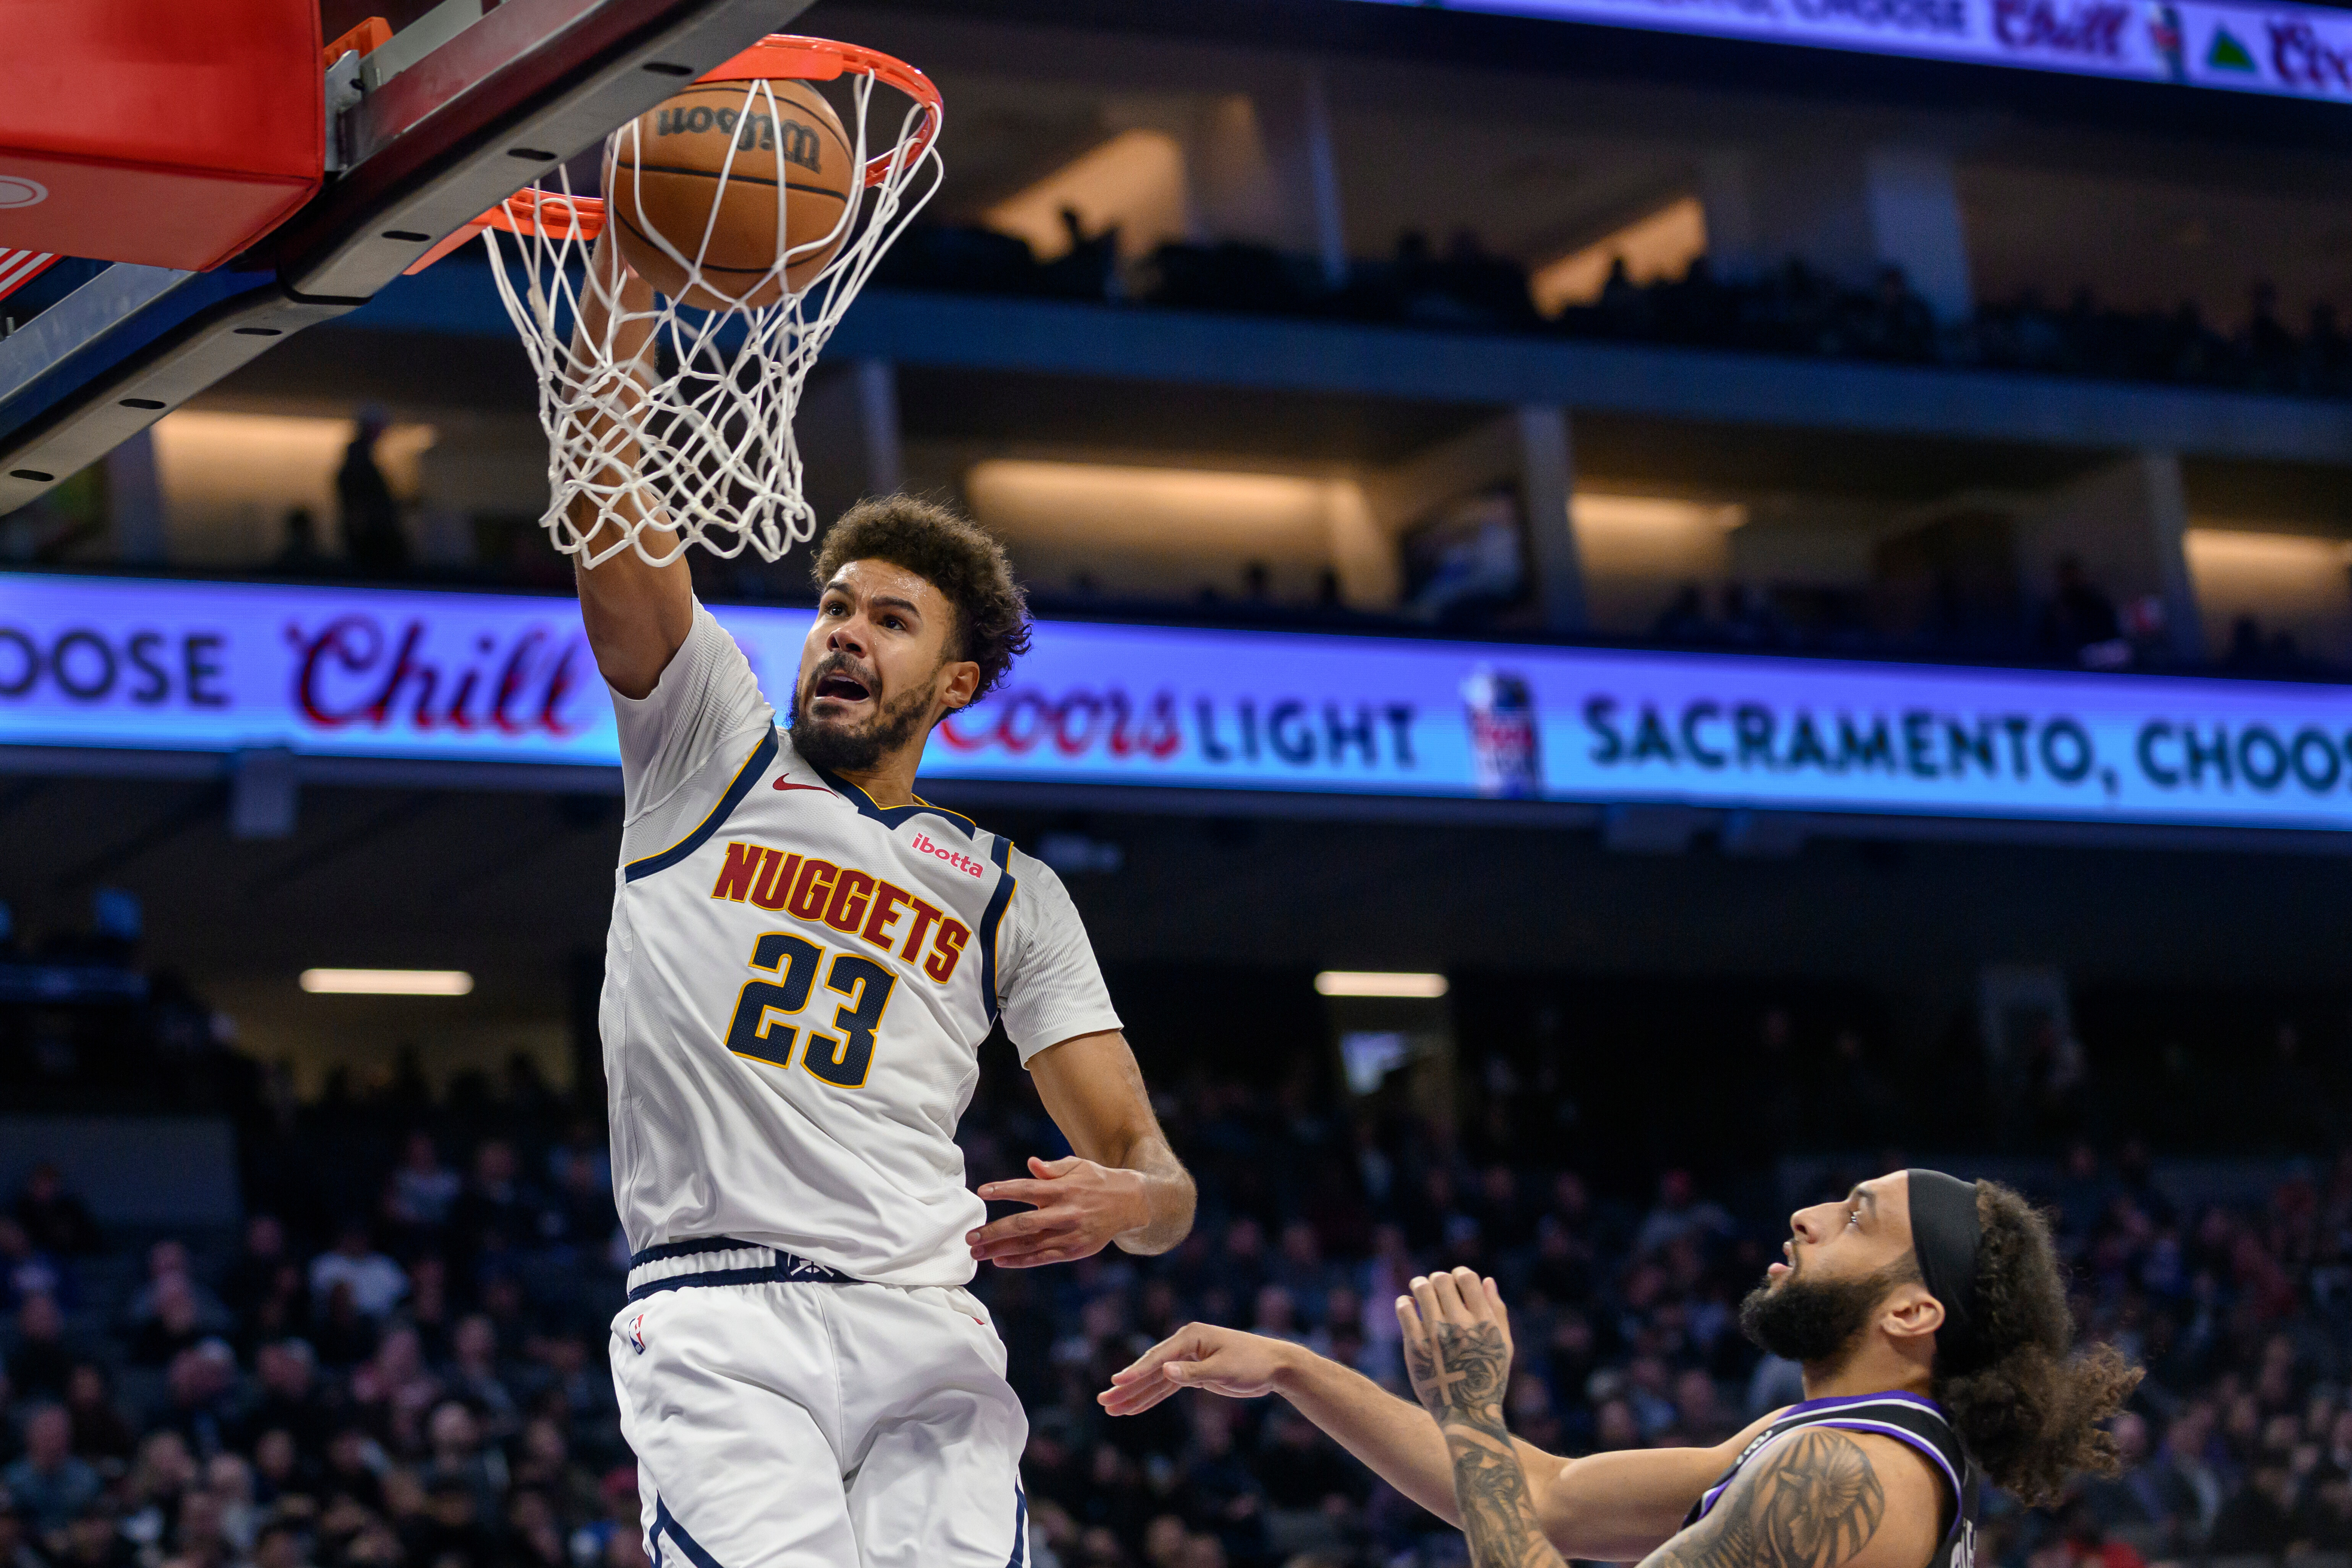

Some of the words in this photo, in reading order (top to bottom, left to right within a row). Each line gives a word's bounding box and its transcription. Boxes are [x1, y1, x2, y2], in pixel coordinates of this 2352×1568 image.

[656, 106, 821, 174] Wilson
[283, 616, 590, 731] Chill
[1193, 697, 1418, 768] LIGHT
[1581, 695, 2119, 797] SACRAMENTO,
[2137, 718, 2352, 796] CHOO
[711, 842, 972, 984] NUGGETS
[912, 832, 983, 878] ibotta
[725, 931, 899, 1089] 23
